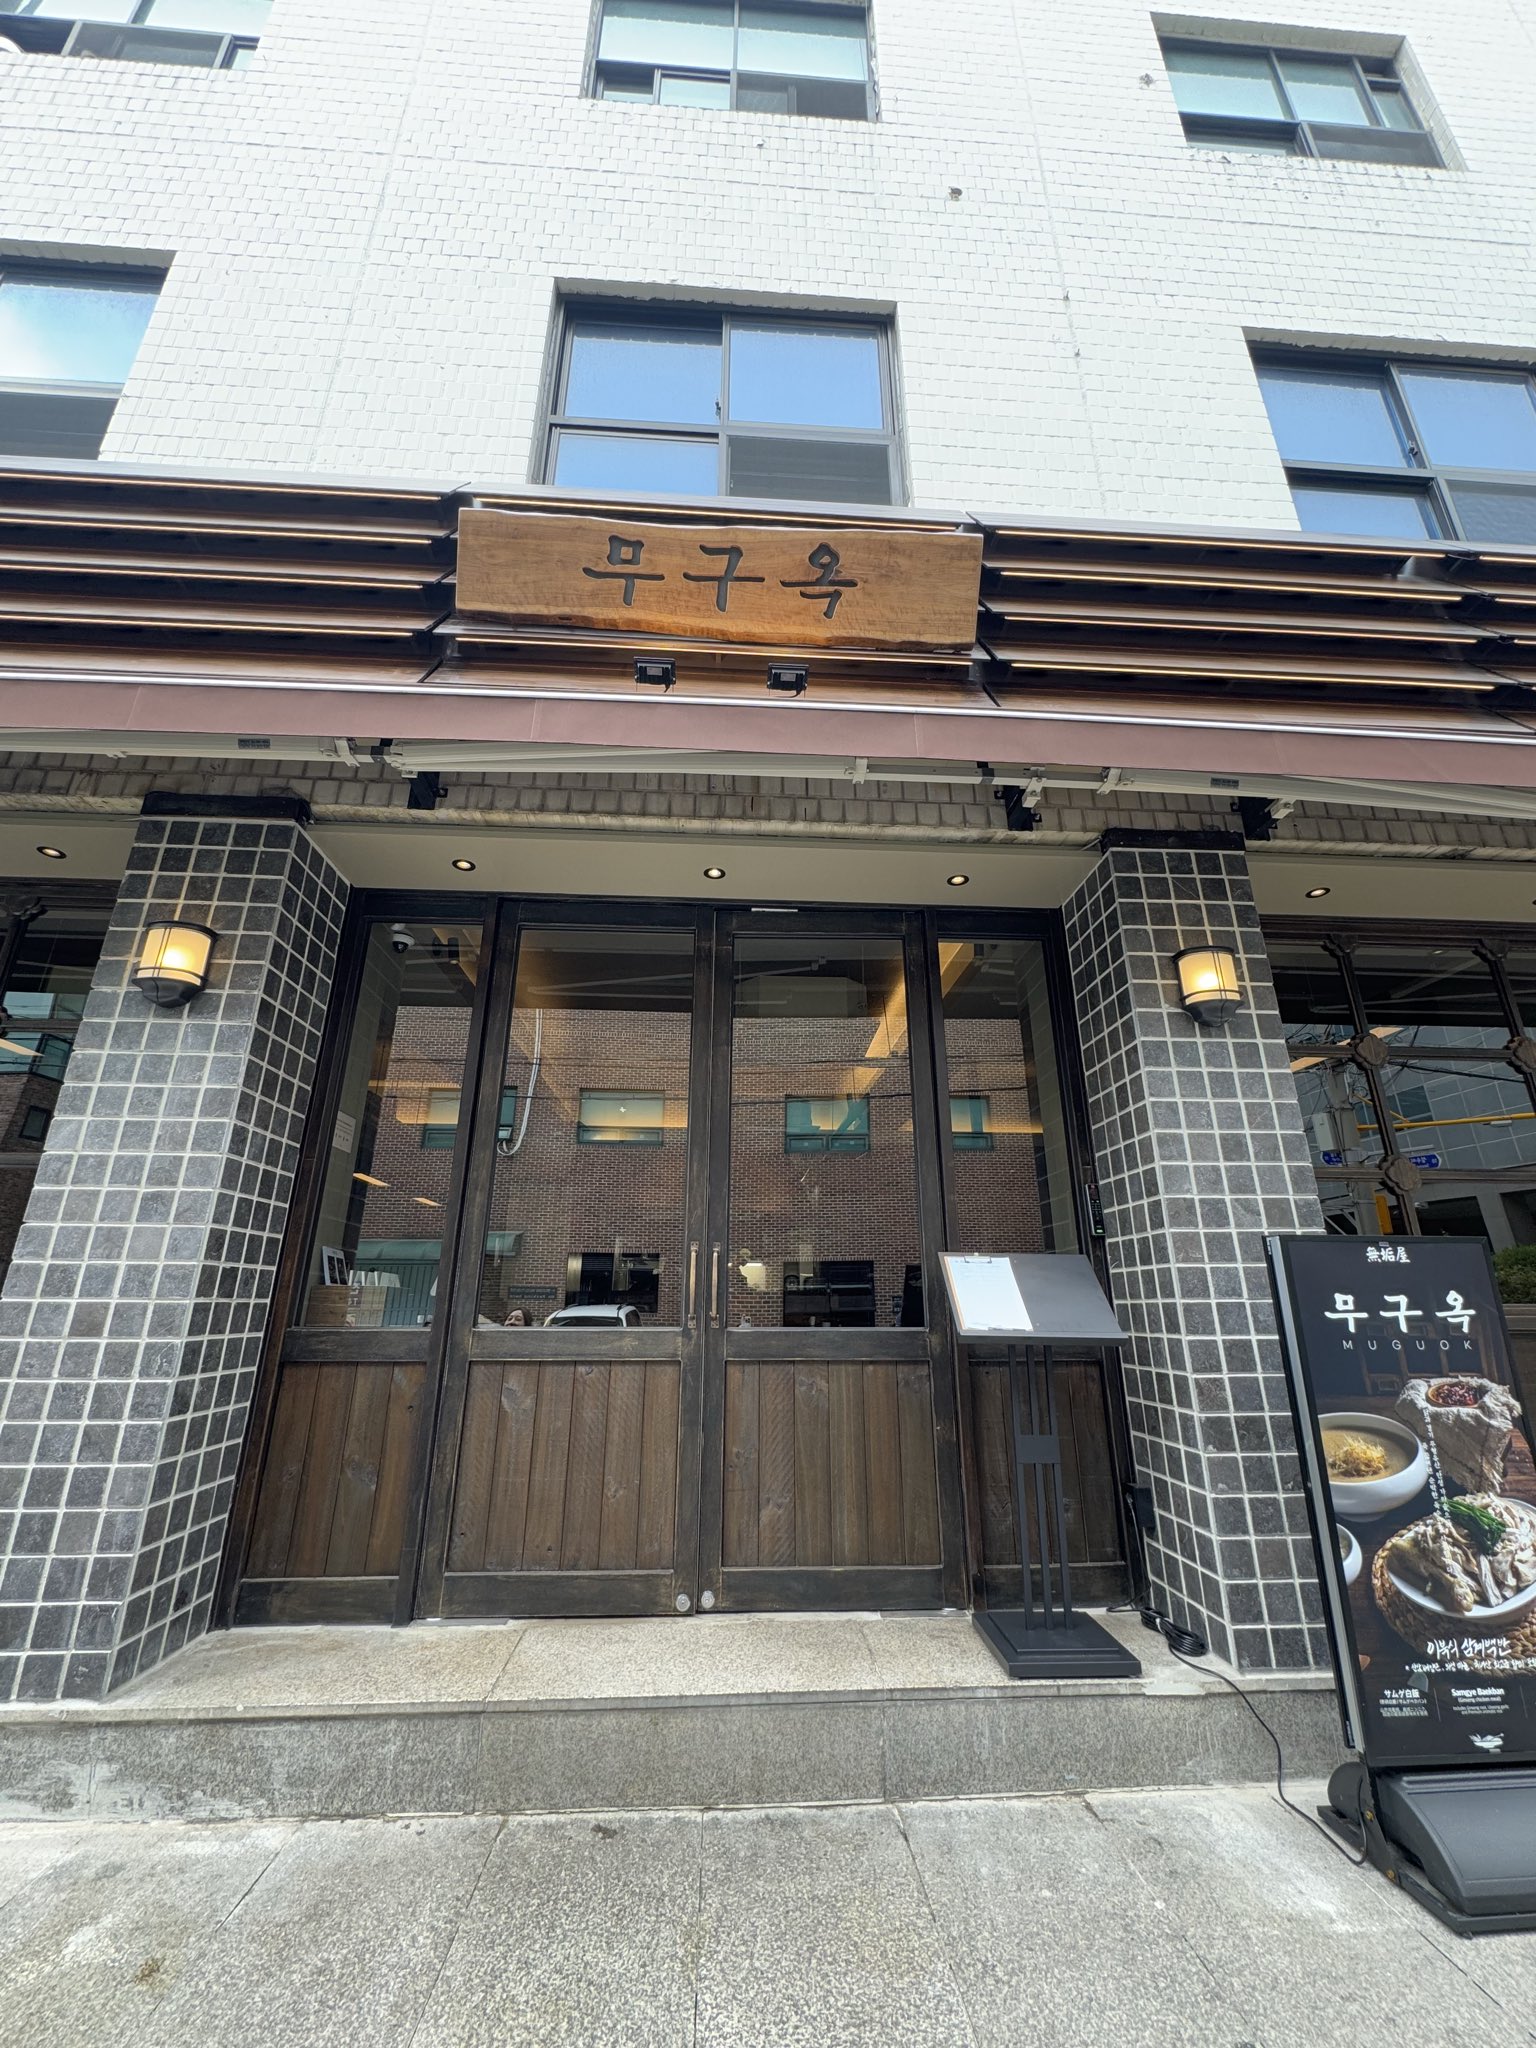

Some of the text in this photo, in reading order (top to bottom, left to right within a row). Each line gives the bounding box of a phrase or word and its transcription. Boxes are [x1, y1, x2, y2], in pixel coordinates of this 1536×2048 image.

[581, 534, 859, 620] 무구옥
[1365, 1246, 1411, 1263] 無垢屋
[1324, 1289, 1476, 1334] 무구옥
[1342, 1339, 1473, 1351] MUGUOK
[1426, 1637, 1512, 1659] 이북식 삼계백반
[1451, 1687, 1477, 1698] Samgye
